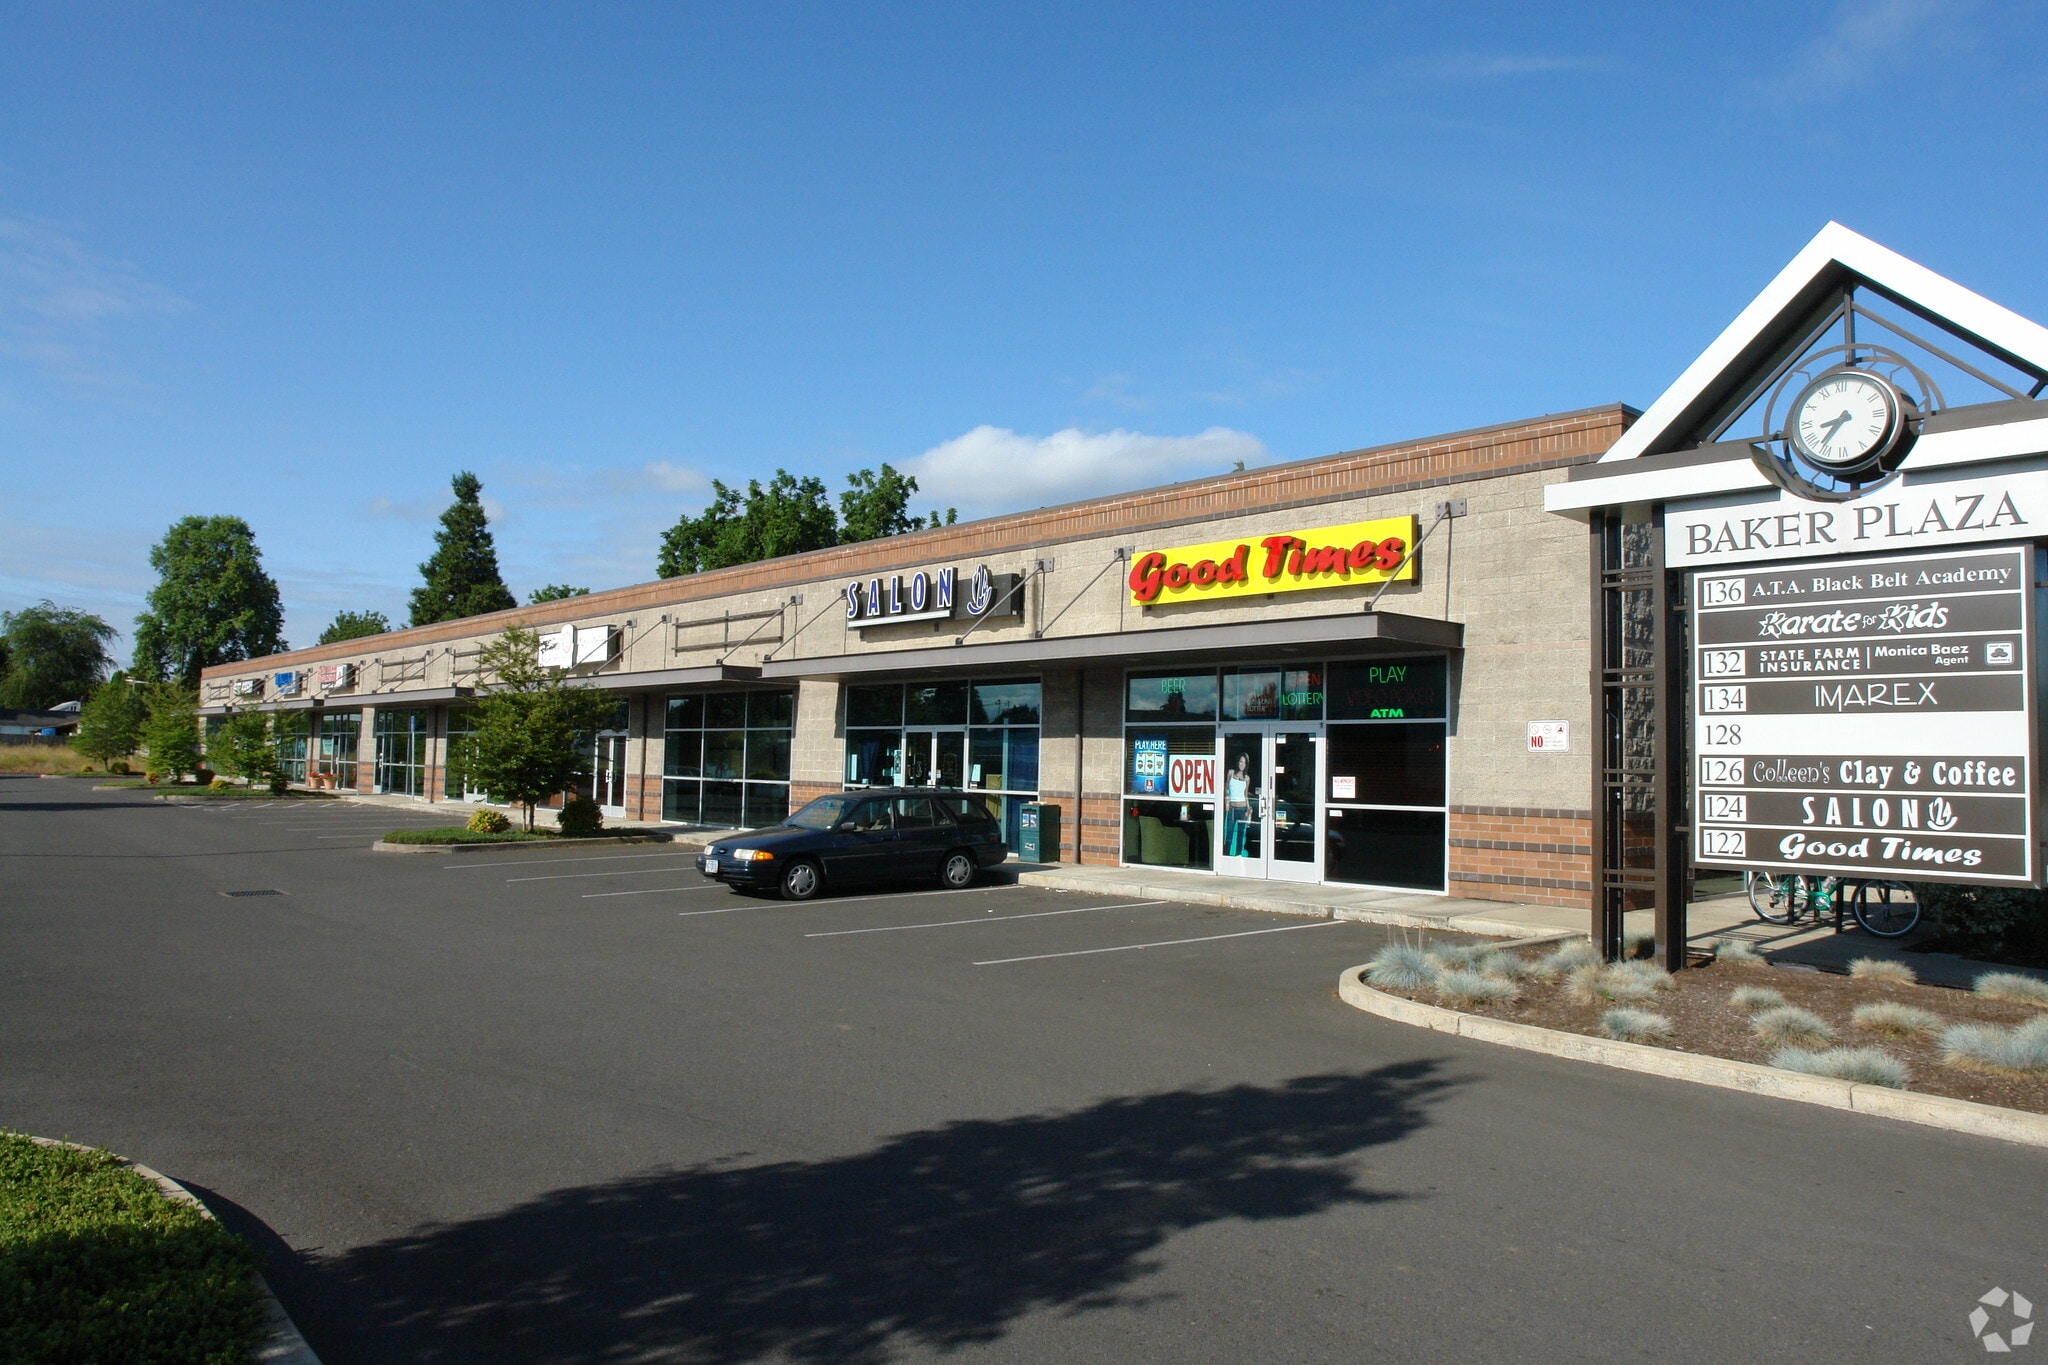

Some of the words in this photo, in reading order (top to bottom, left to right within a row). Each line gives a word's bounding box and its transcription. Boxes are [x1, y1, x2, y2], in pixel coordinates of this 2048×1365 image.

[1685, 511, 1836, 555] BAKER
[1853, 490, 2028, 540] PLAZA
[1129, 544, 1250, 601] Good
[1261, 535, 1405, 578] Times
[846, 567, 955, 619] SALON
[1705, 580, 1742, 603] 136
[1752, 580, 1805, 597] A.T.A.
[1812, 575, 1863, 592] Black
[1870, 572, 1908, 589] Belt
[1915, 567, 2012, 585] Academy
[1758, 609, 1862, 639] Karate
[1862, 615, 1877, 629] for
[1878, 601, 1949, 633] Kids
[1705, 652, 1741, 674] 132
[1759, 649, 1804, 661] STATE
[1814, 647, 1860, 660] FARM
[1874, 645, 1927, 657] Monica
[1930, 643, 1969, 655] Baez
[1759, 659, 1861, 673] INSURANCE
[1934, 656, 1969, 666] Agent
[1161, 678, 1186, 694] BEER
[1288, 672, 1322, 687] OPEN
[1369, 666, 1407, 684] PLAY
[1706, 688, 1743, 710] 134
[1815, 682, 1938, 712] IMAREX
[1370, 708, 1404, 718] ATM
[1134, 740, 1149, 750] PLAY
[1150, 740, 1166, 750] HERE
[1531, 735, 1543, 748] NO
[1705, 724, 1741, 745] 128
[1171, 759, 1215, 795] OPEN
[1704, 760, 1743, 782] 126
[1753, 759, 1830, 784] Colleen's
[1839, 760, 1893, 789] Clay
[1903, 761, 1921, 785] &
[1932, 760, 2016, 786] Coffee
[1706, 796, 1743, 818] 124
[1802, 796, 1919, 828] SALON
[1705, 832, 1744, 855] 122
[1779, 833, 1869, 860] Good
[1880, 837, 1982, 866] Times
